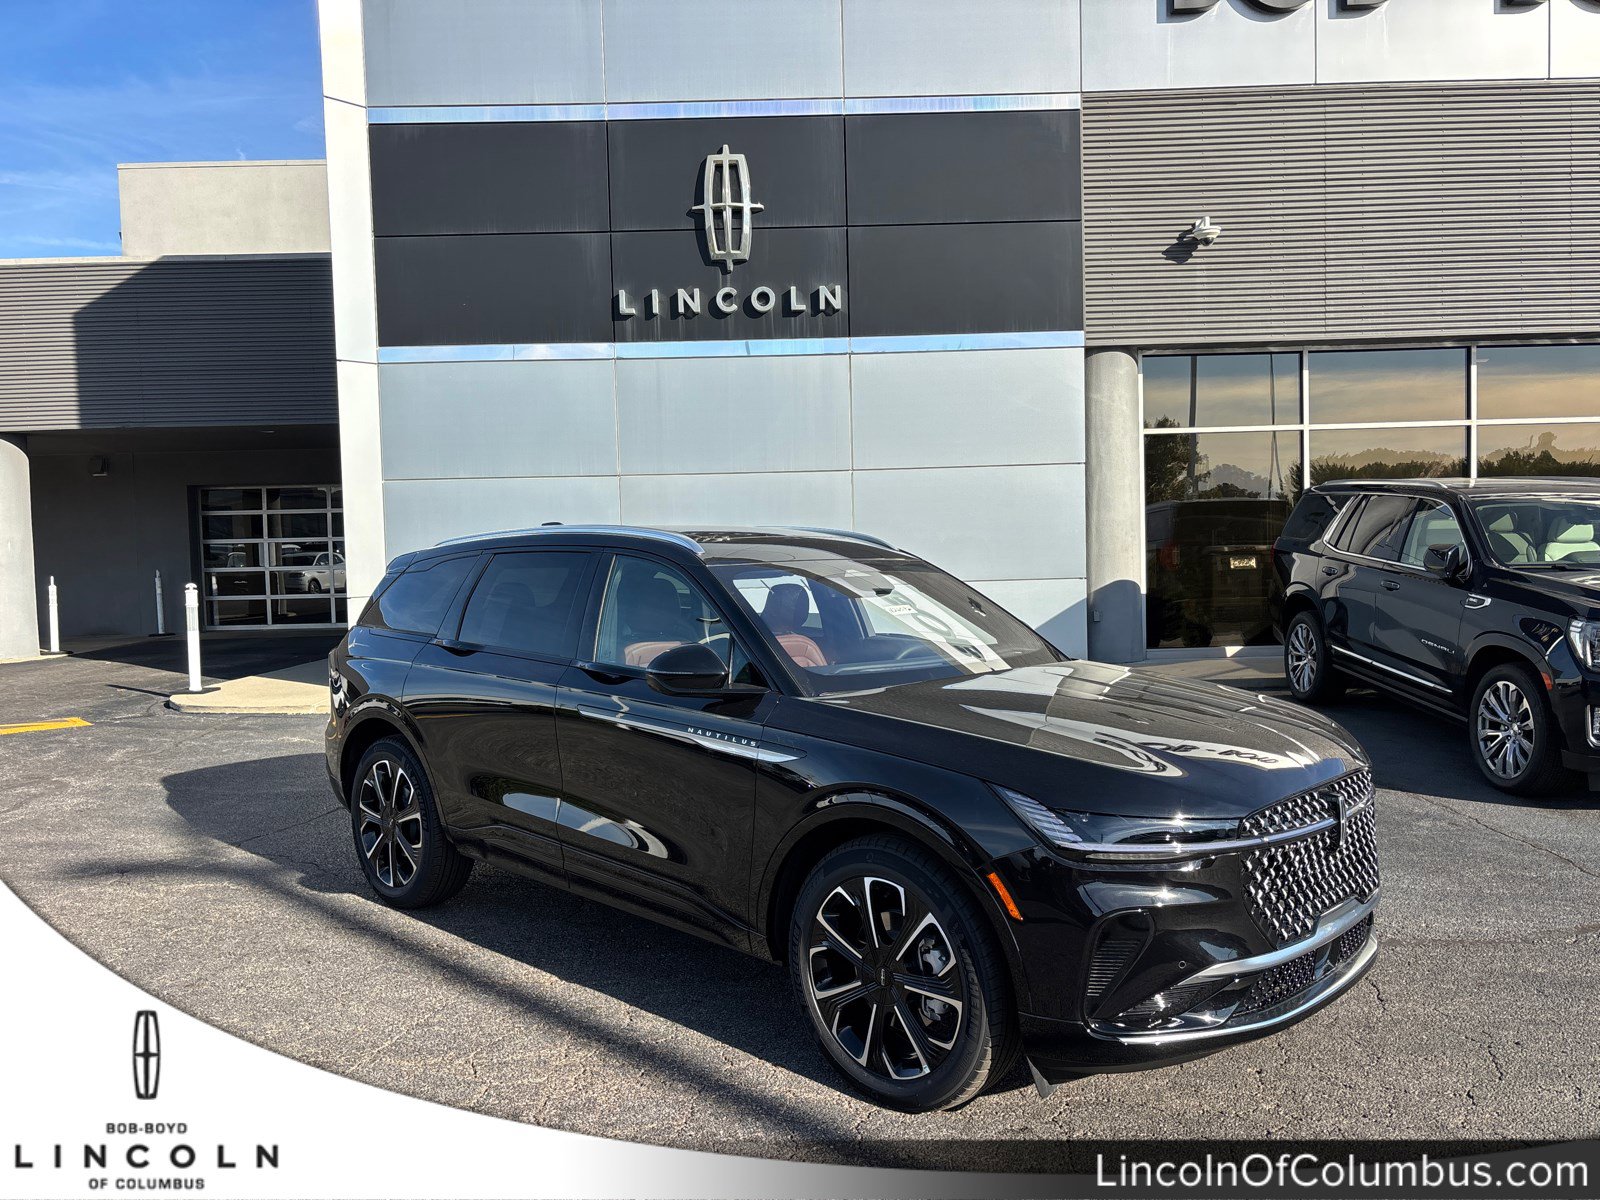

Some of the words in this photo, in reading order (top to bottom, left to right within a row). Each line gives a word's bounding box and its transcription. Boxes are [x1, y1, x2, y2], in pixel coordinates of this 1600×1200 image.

[618, 284, 842, 316] LINCOLN
[1421, 638, 1455, 654] DENALI
[687, 727, 757, 747] NAUTILUS
